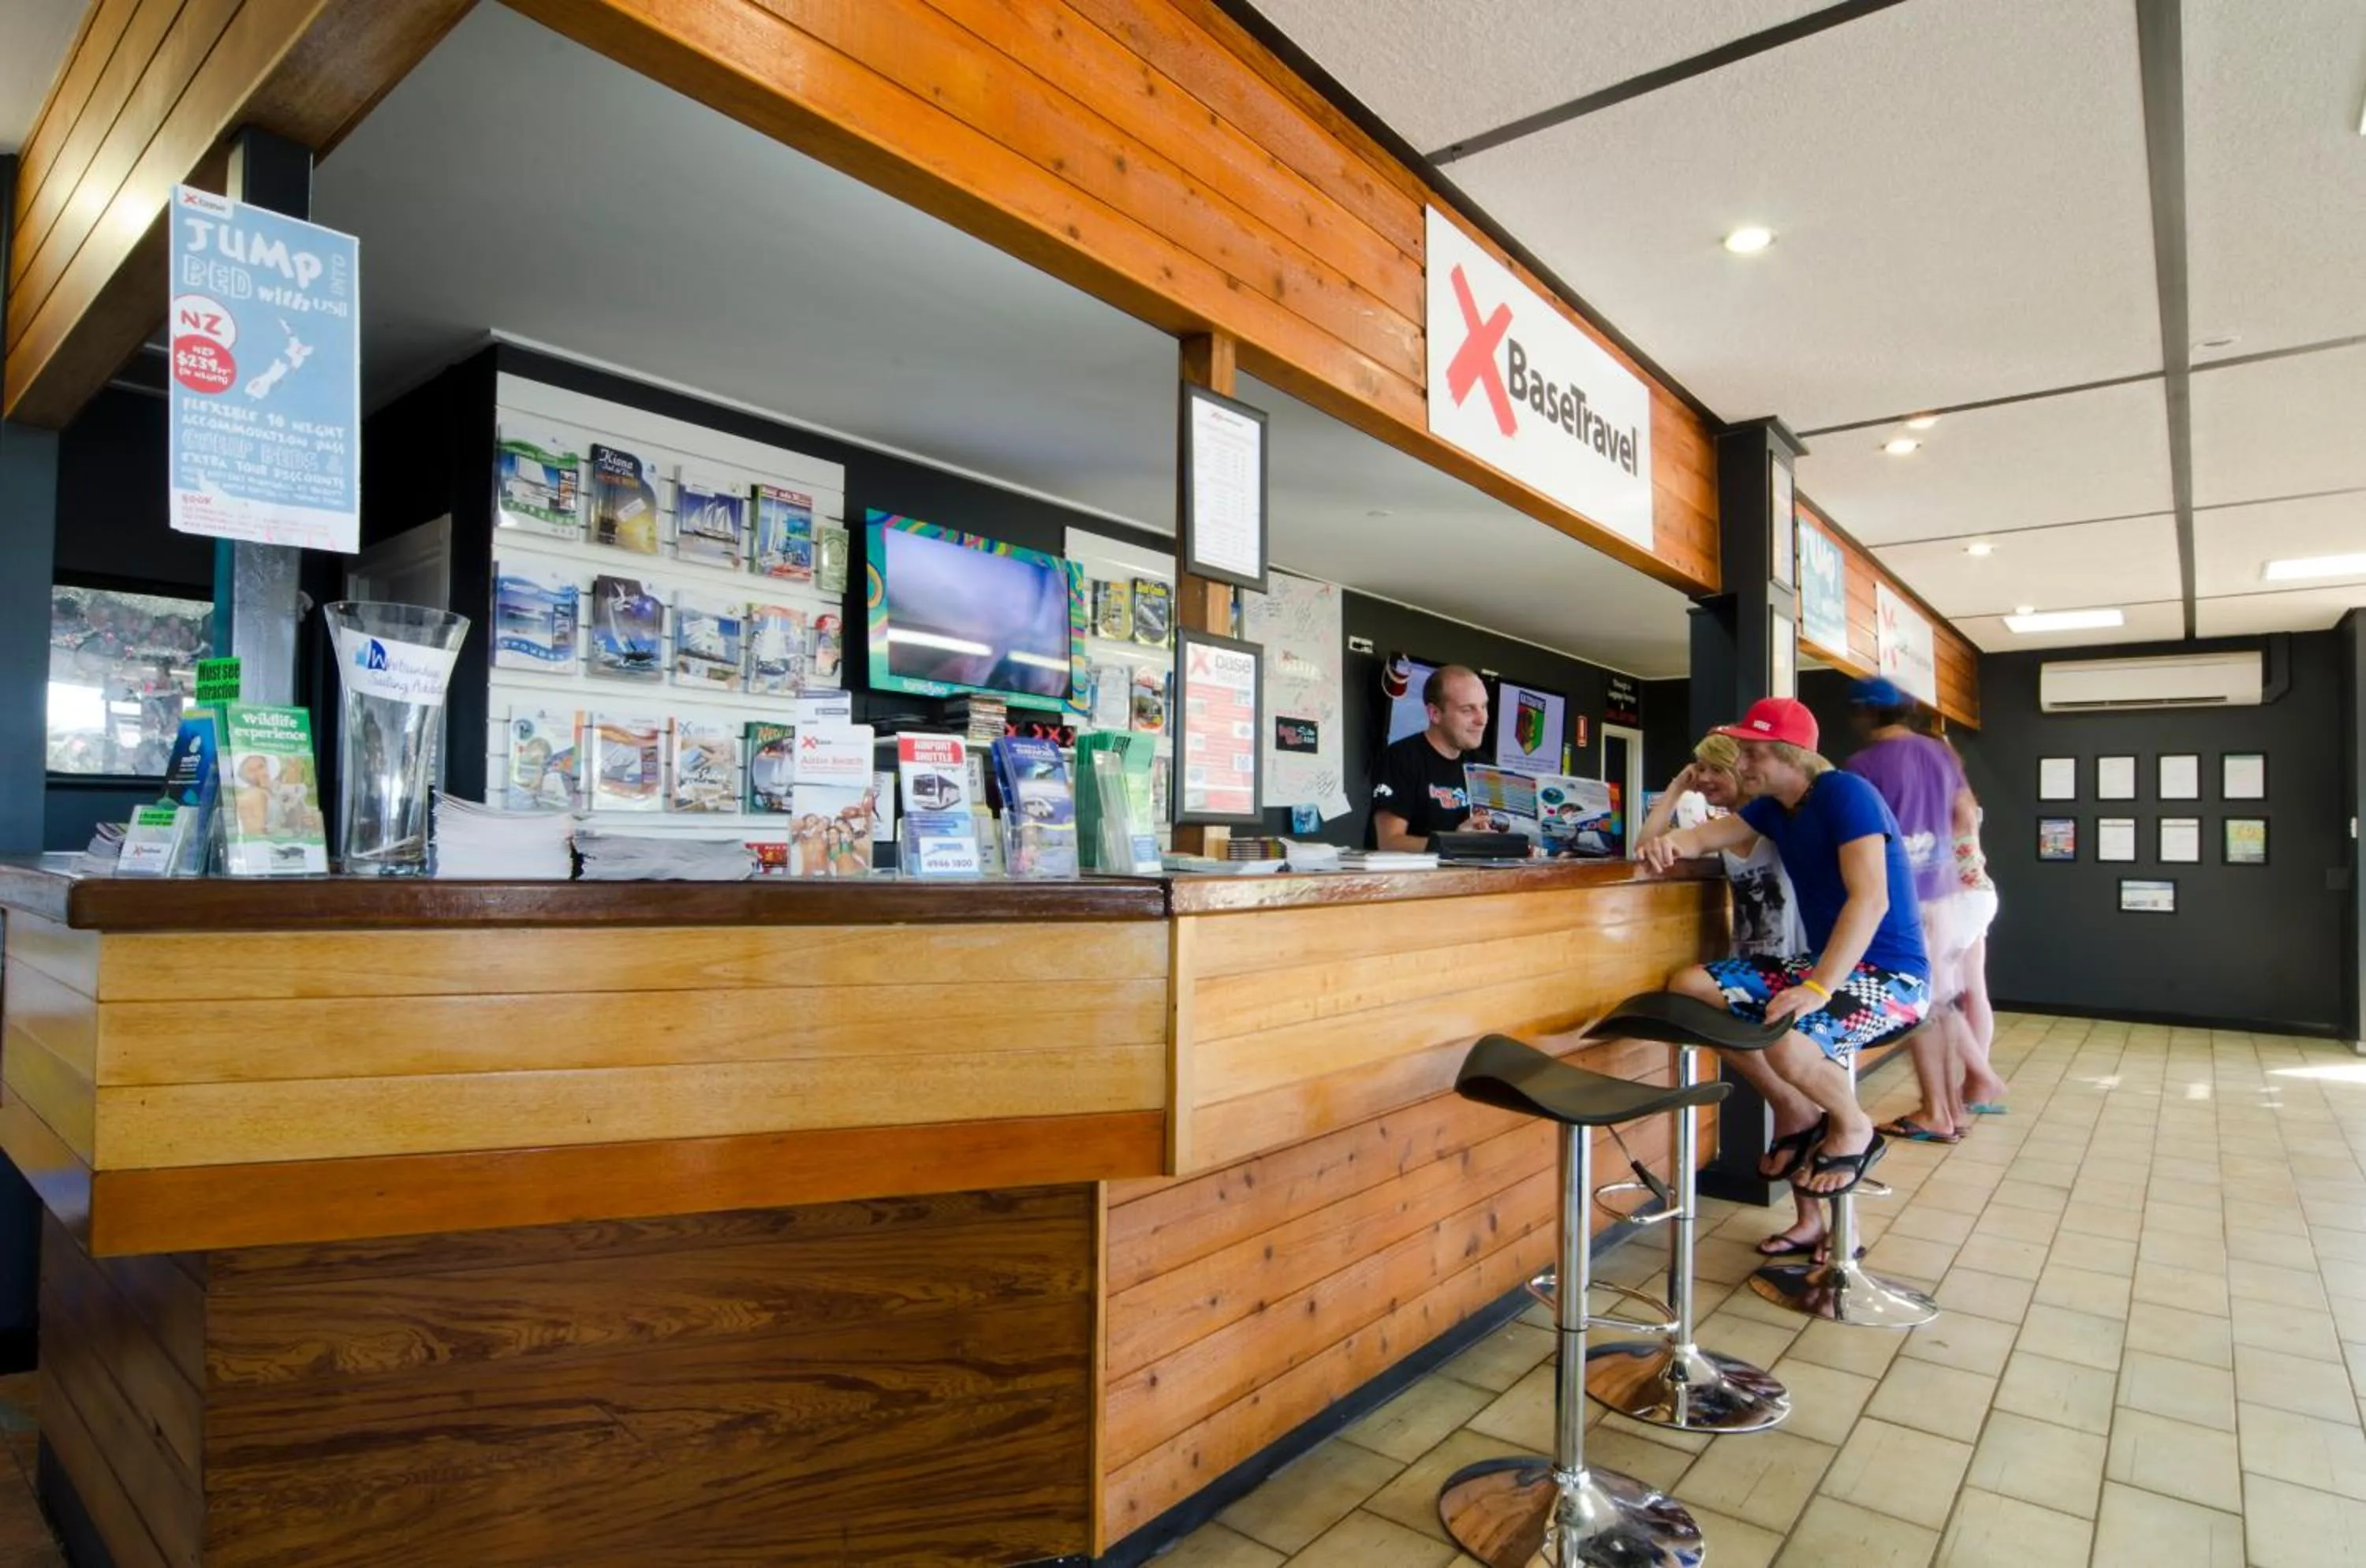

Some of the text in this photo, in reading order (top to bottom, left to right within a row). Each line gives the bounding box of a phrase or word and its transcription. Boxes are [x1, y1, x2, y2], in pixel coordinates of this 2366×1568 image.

[185, 218, 323, 289] JUMP
[180, 309, 222, 336] NZ
[1507, 336, 1638, 477] BaseTravel
